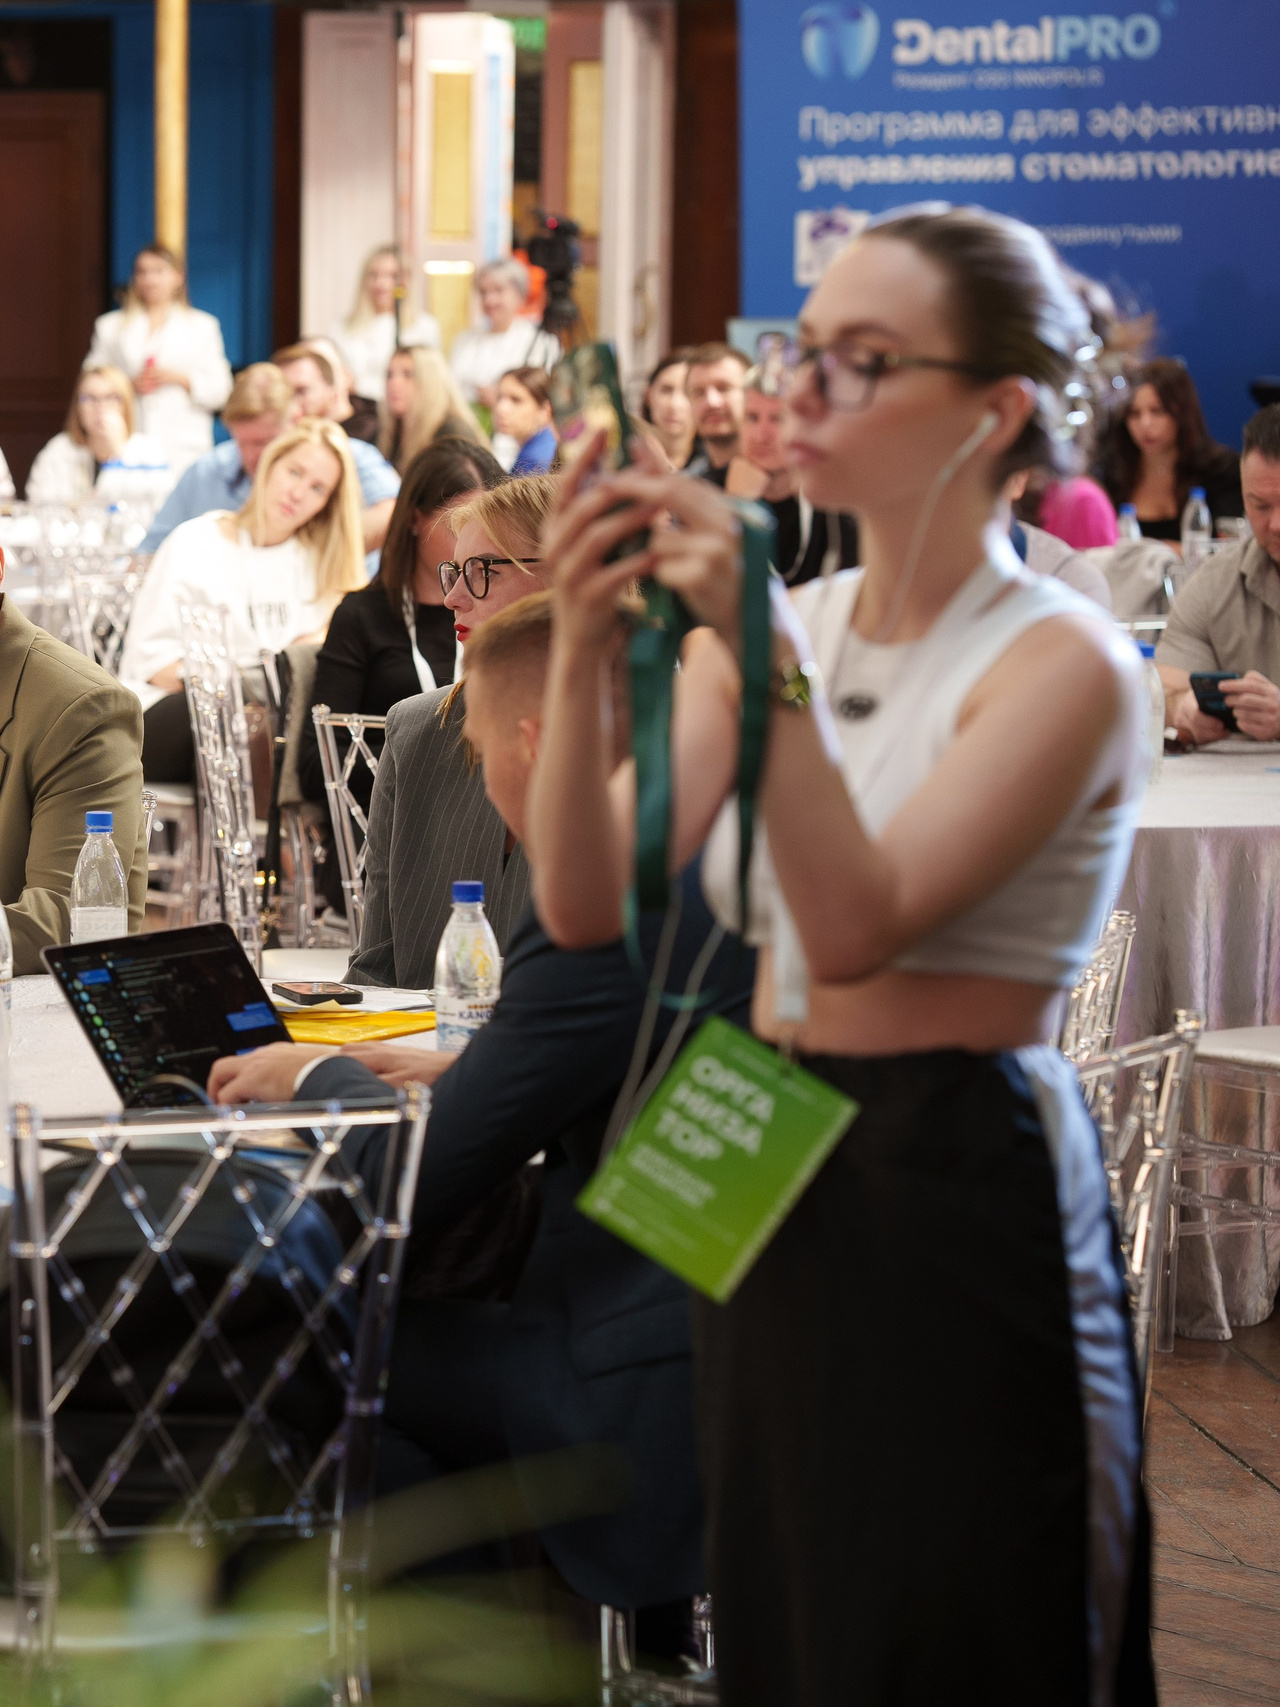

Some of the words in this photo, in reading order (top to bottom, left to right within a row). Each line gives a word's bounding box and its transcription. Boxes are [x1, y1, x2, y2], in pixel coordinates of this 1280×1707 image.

[893, 14, 1161, 65] DentalPRO
[799, 106, 1004, 148] Программа
[1008, 108, 1079, 144] для
[796, 153, 1016, 192] управления
[458, 1009, 495, 1020] KANG
